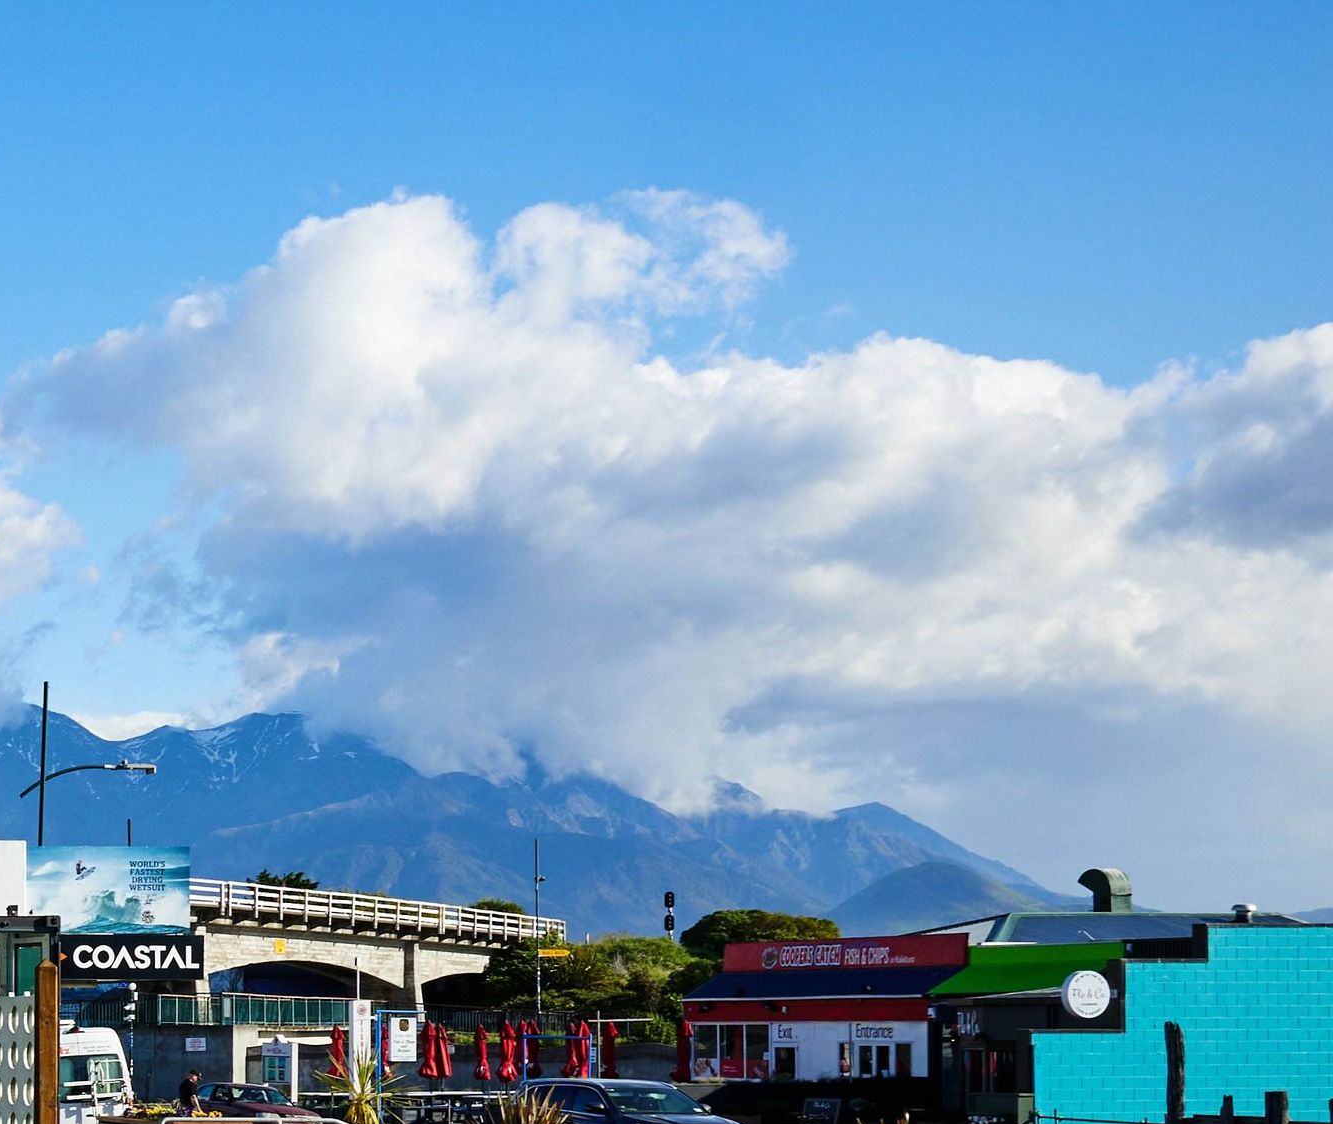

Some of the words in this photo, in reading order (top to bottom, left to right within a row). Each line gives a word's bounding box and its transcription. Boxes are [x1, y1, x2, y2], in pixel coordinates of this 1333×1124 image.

[129, 860, 166, 868] WORLD'S
[129, 868, 166, 876] FASTEST
[131, 876, 164, 884] DRYING
[129, 884, 166, 892] WETSUIT
[73, 944, 200, 970] COASTAL
[780, 945, 813, 967] COOPERS
[815, 944, 842, 966] CATCH
[844, 948, 860, 965] FISH
[868, 947, 890, 964] CHIPS
[778, 1024, 793, 1039] Exit
[856, 1023, 893, 1039] Entrance
